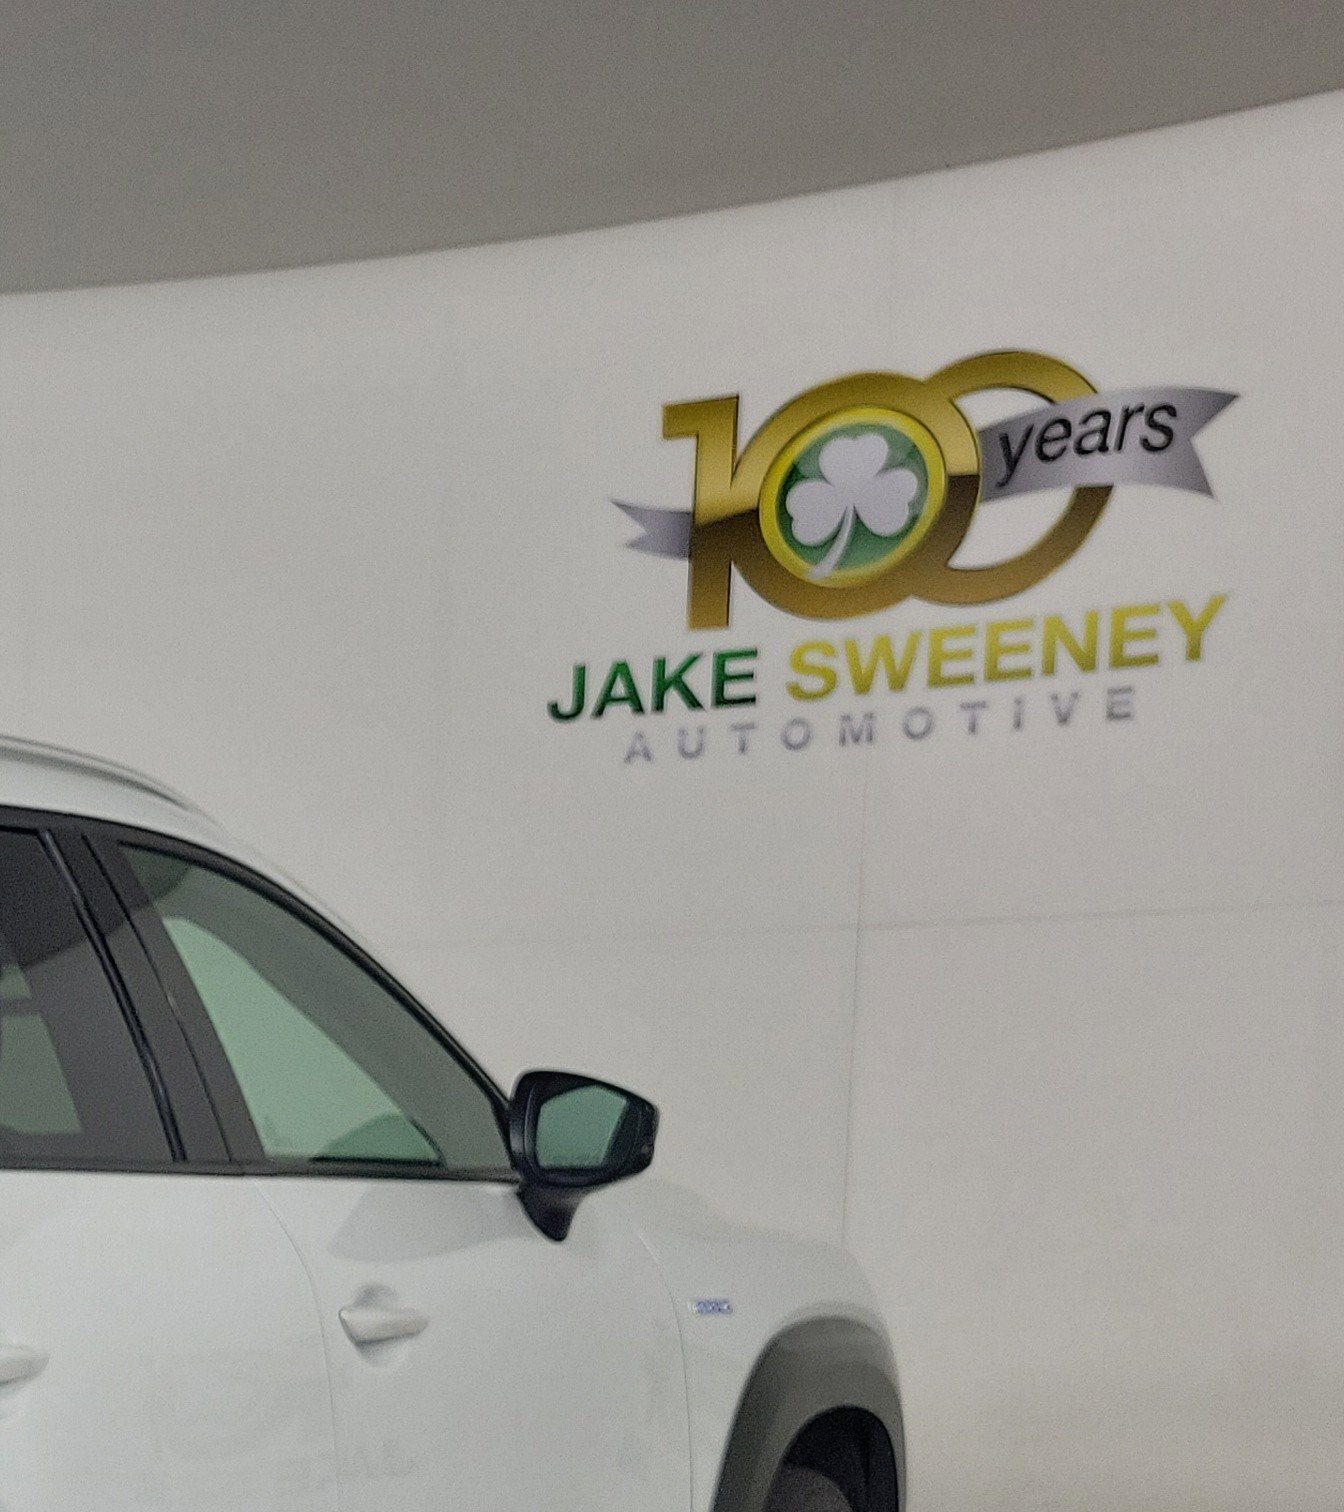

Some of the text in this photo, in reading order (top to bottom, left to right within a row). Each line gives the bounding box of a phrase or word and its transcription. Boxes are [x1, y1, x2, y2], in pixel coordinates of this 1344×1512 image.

[996, 399, 1179, 487] years
[546, 594, 1228, 724] JAKE SWEENEY
[623, 686, 1136, 765] AUTOMOTIVE
